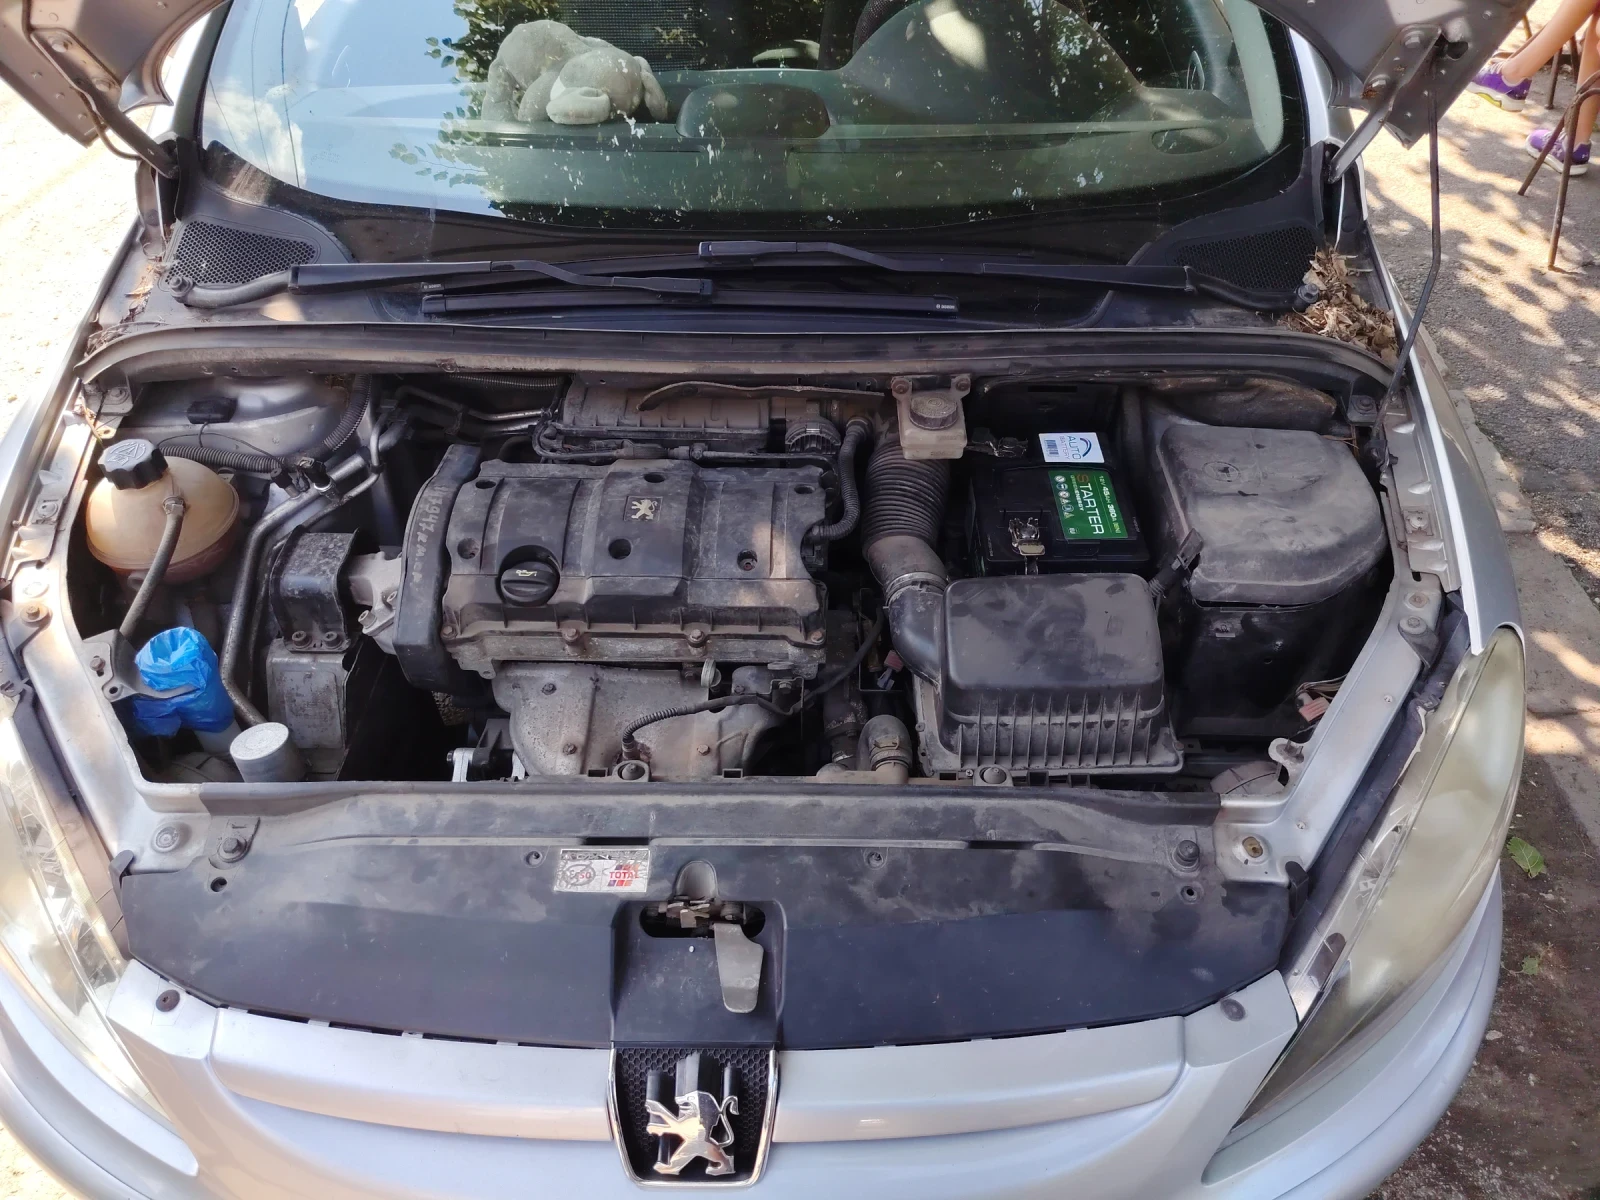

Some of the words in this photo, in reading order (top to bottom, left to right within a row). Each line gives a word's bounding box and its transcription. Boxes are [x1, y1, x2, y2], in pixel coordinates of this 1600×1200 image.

[1059, 436, 1070, 460] BATTERY
[1068, 436, 1081, 460] AUTO
[1076, 474, 1105, 535] STARTER
[609, 871, 640, 879] TOTAL
